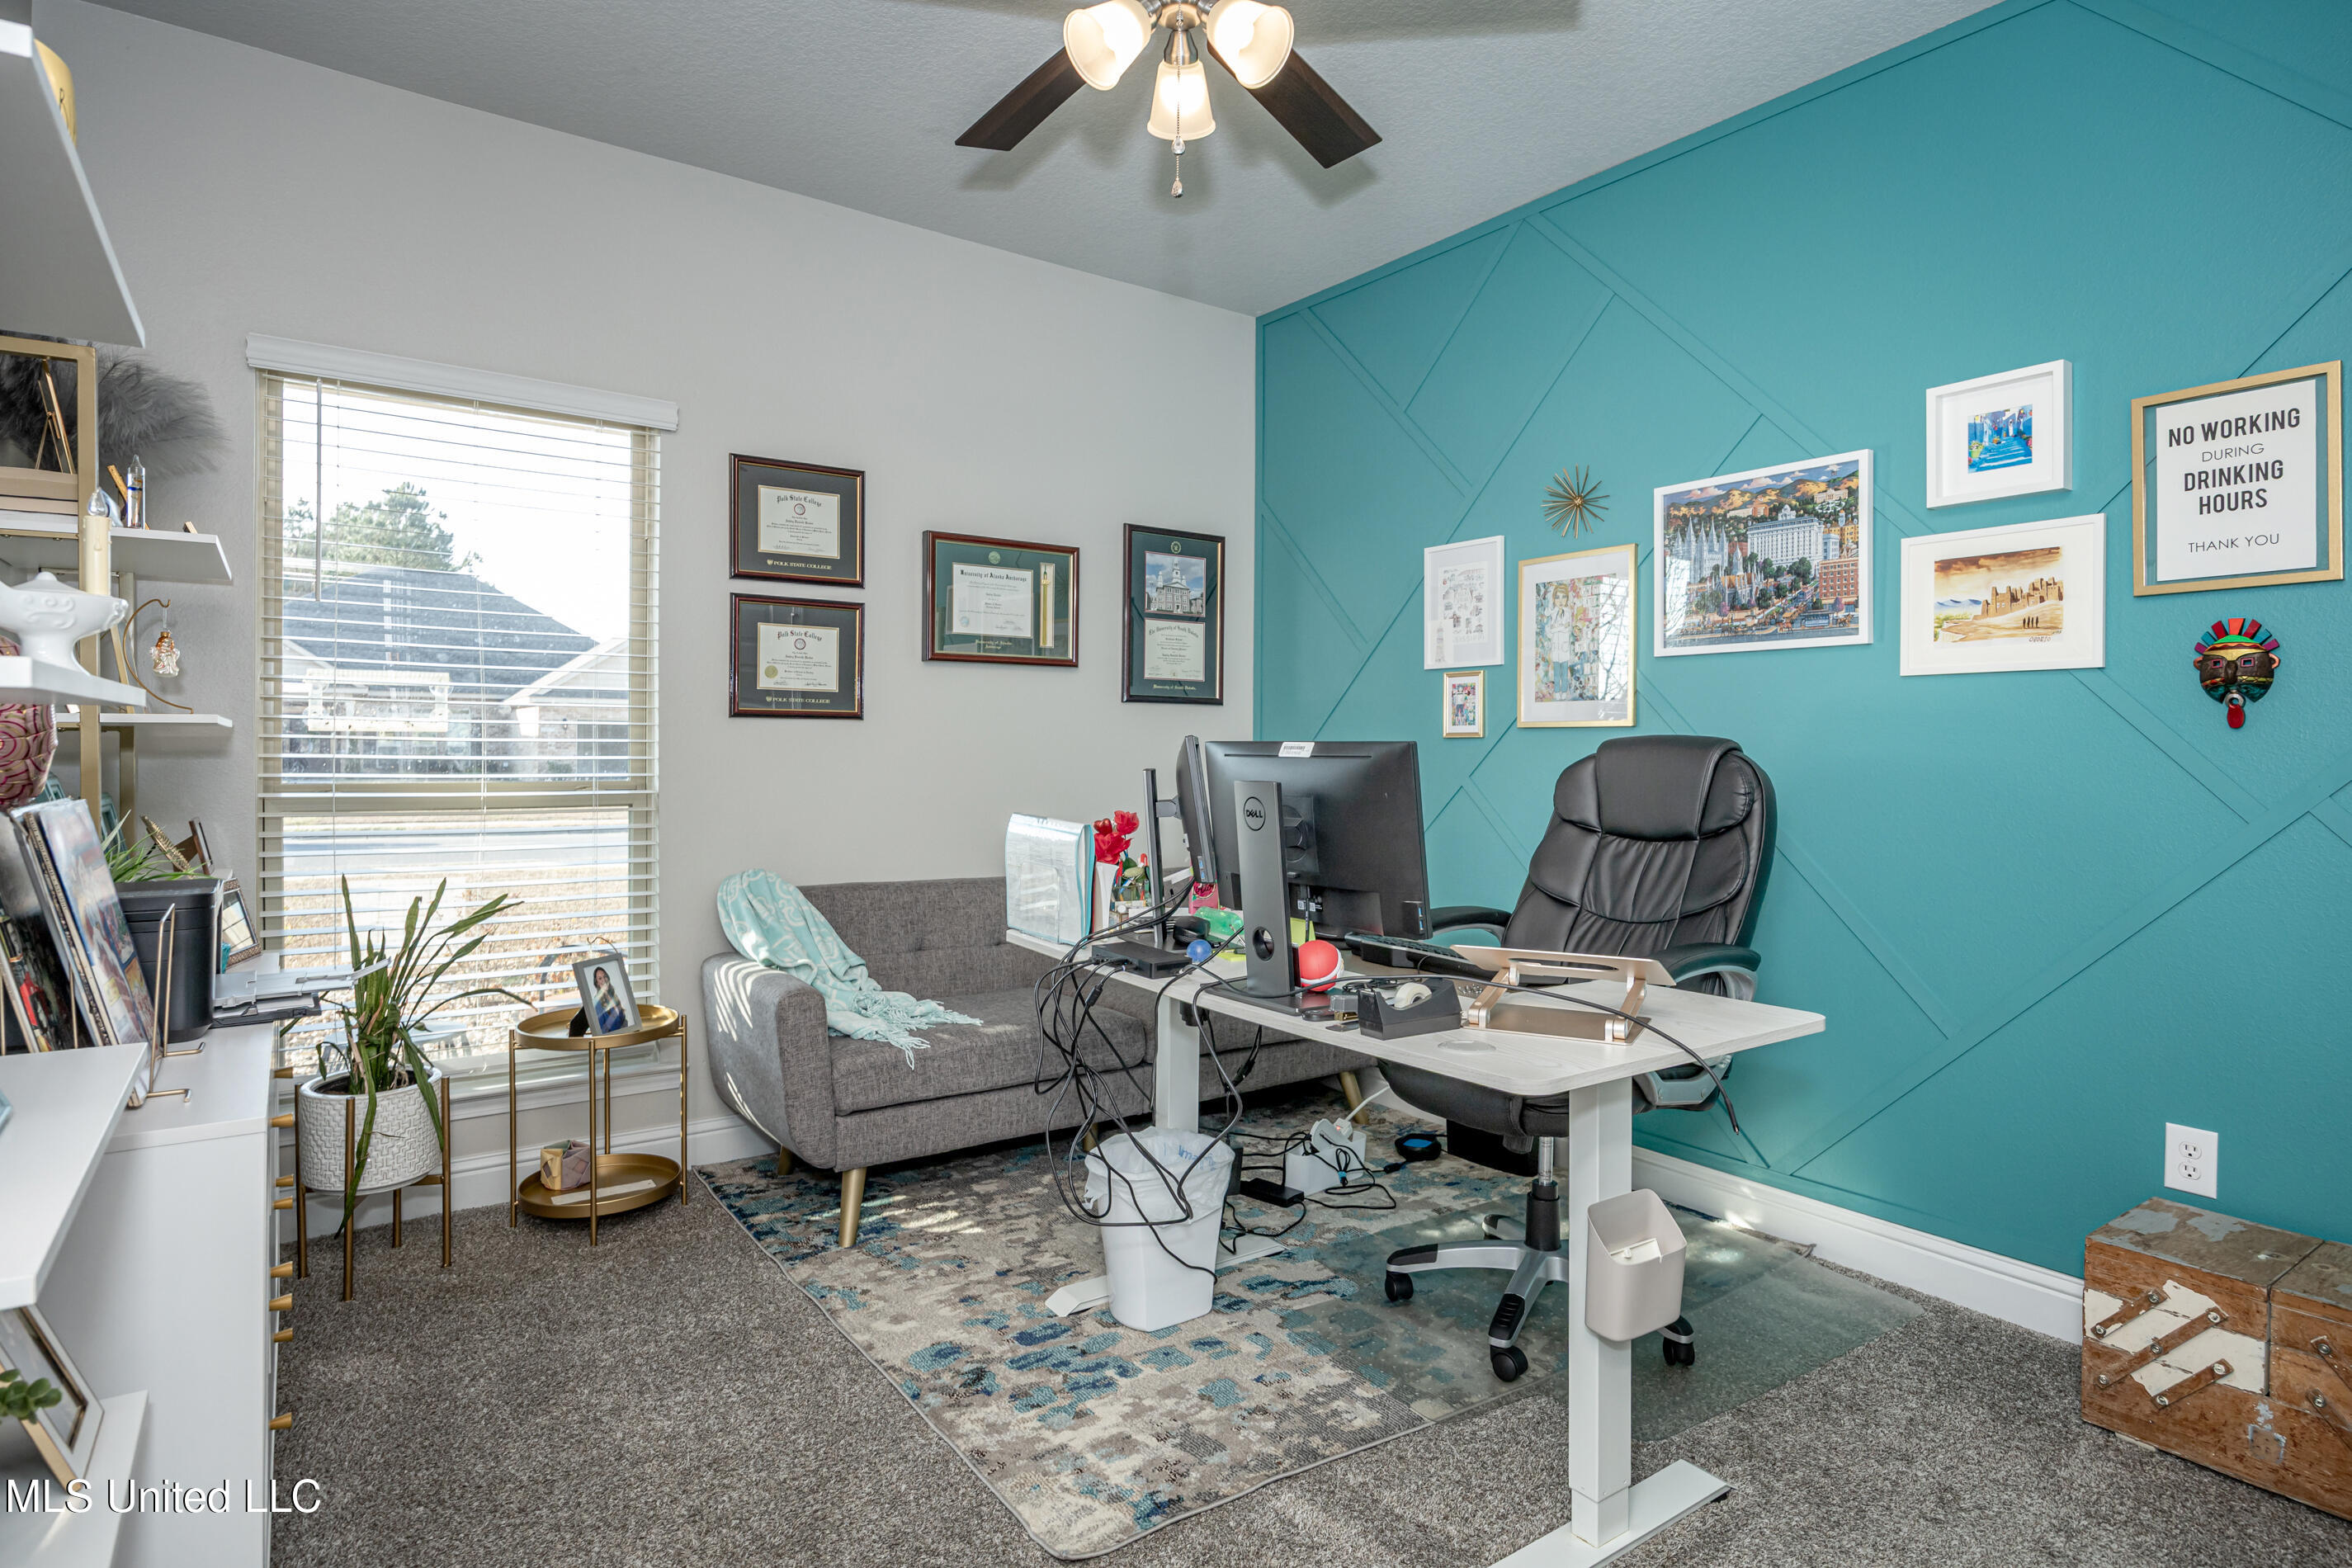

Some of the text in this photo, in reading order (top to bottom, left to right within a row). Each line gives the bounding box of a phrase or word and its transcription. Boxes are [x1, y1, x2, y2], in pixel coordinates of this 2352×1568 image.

[2168, 408, 2301, 447] NO WORKING
[2202, 443, 2265, 462] DURING
[2184, 460, 2284, 492] DRINKING
[777, 495, 789, 504] Polk
[803, 496, 822, 507] College
[2199, 488, 2268, 516] HOURS
[2188, 533, 2279, 553] THANK YOU
[960, 569, 982, 579] University
[1006, 574, 1027, 583] Anchorage
[777, 631, 789, 640] Polk
[804, 631, 822, 641] College
[1246, 809, 1263, 818] DELL
